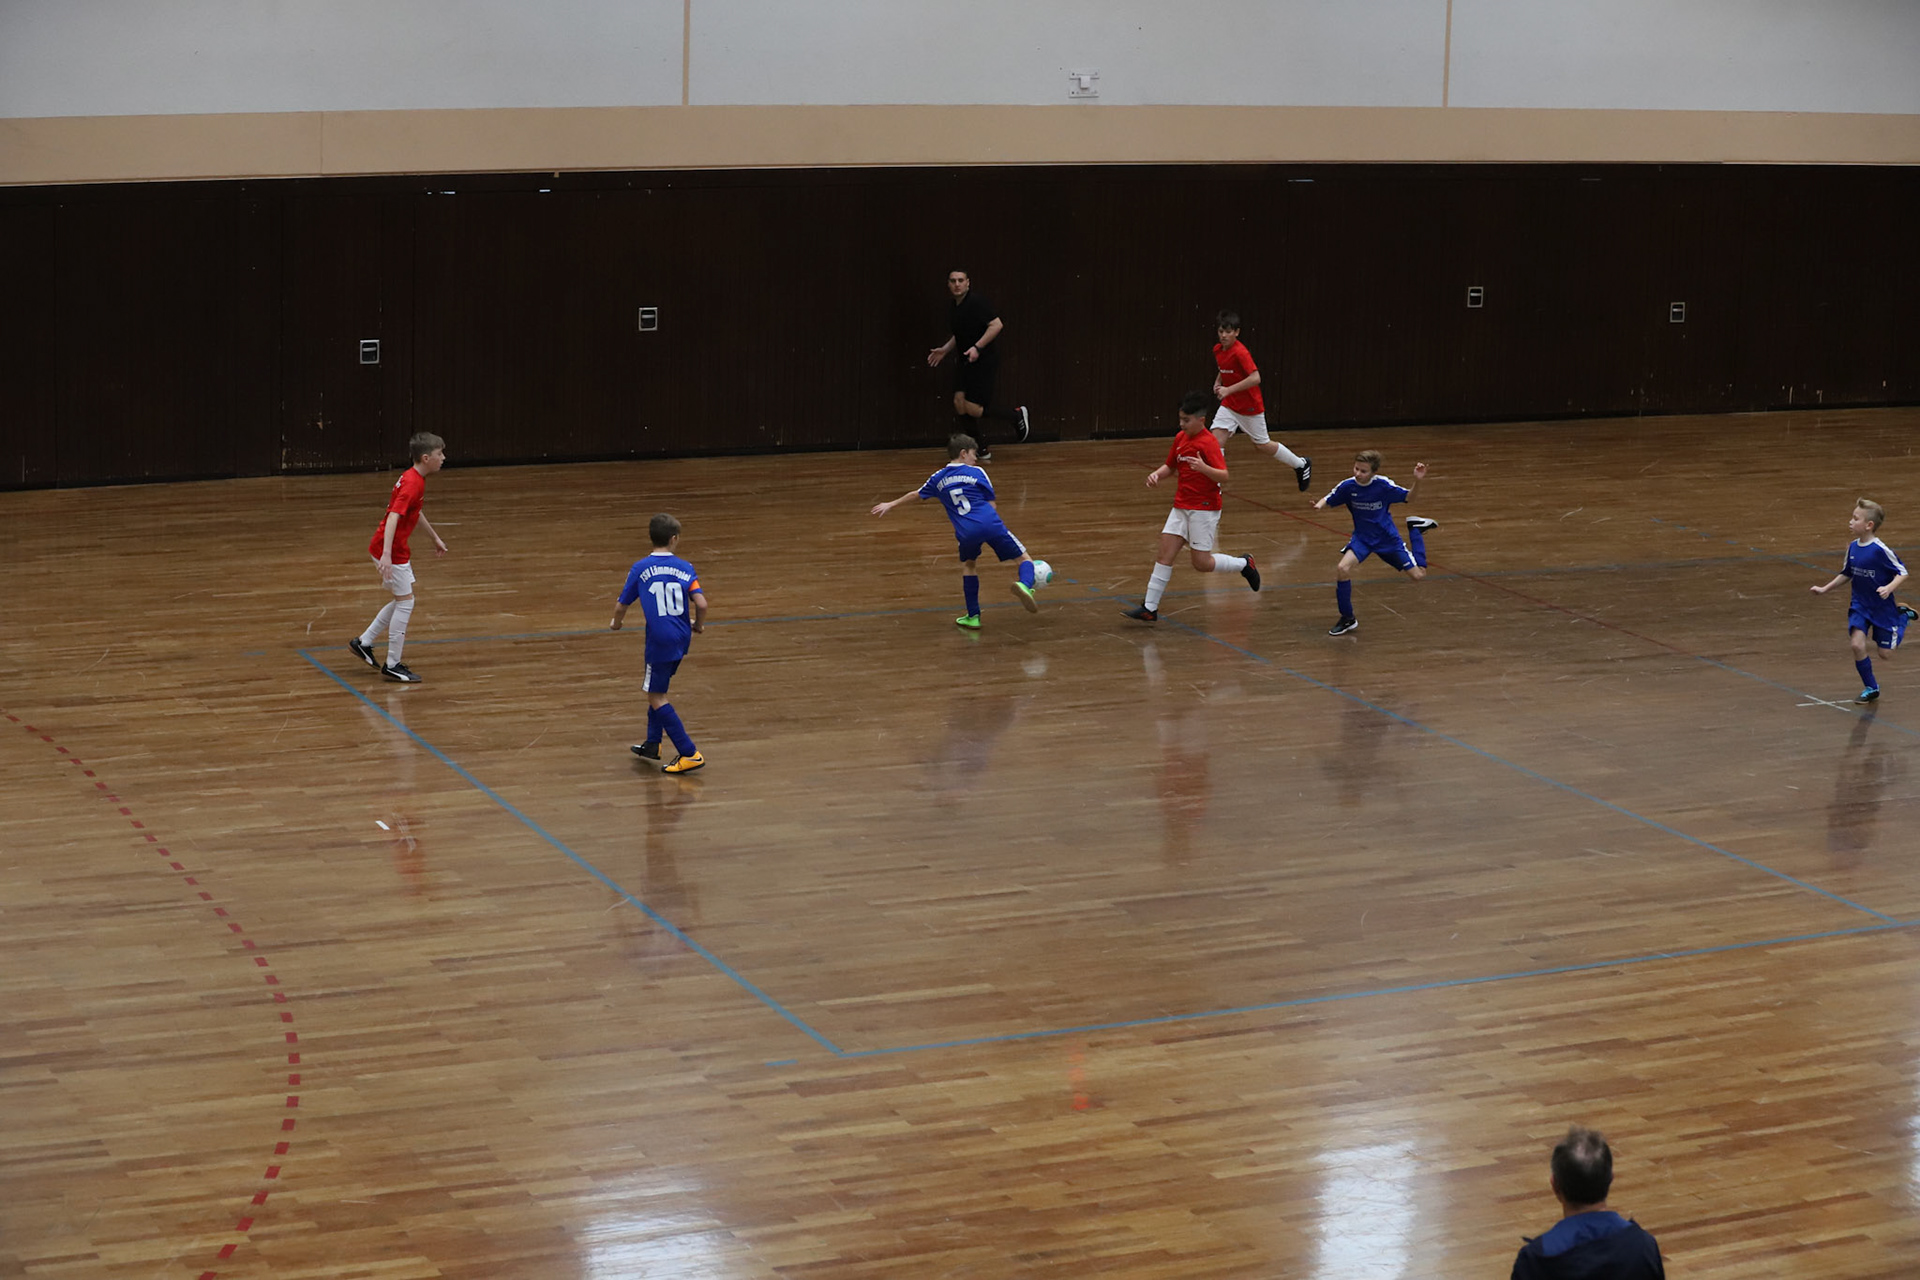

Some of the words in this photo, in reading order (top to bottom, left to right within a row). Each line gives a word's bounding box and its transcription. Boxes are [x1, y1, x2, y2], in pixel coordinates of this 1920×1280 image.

[949, 488, 971, 516] 5
[639, 568, 652, 583] TSV
[648, 581, 685, 617] 10
